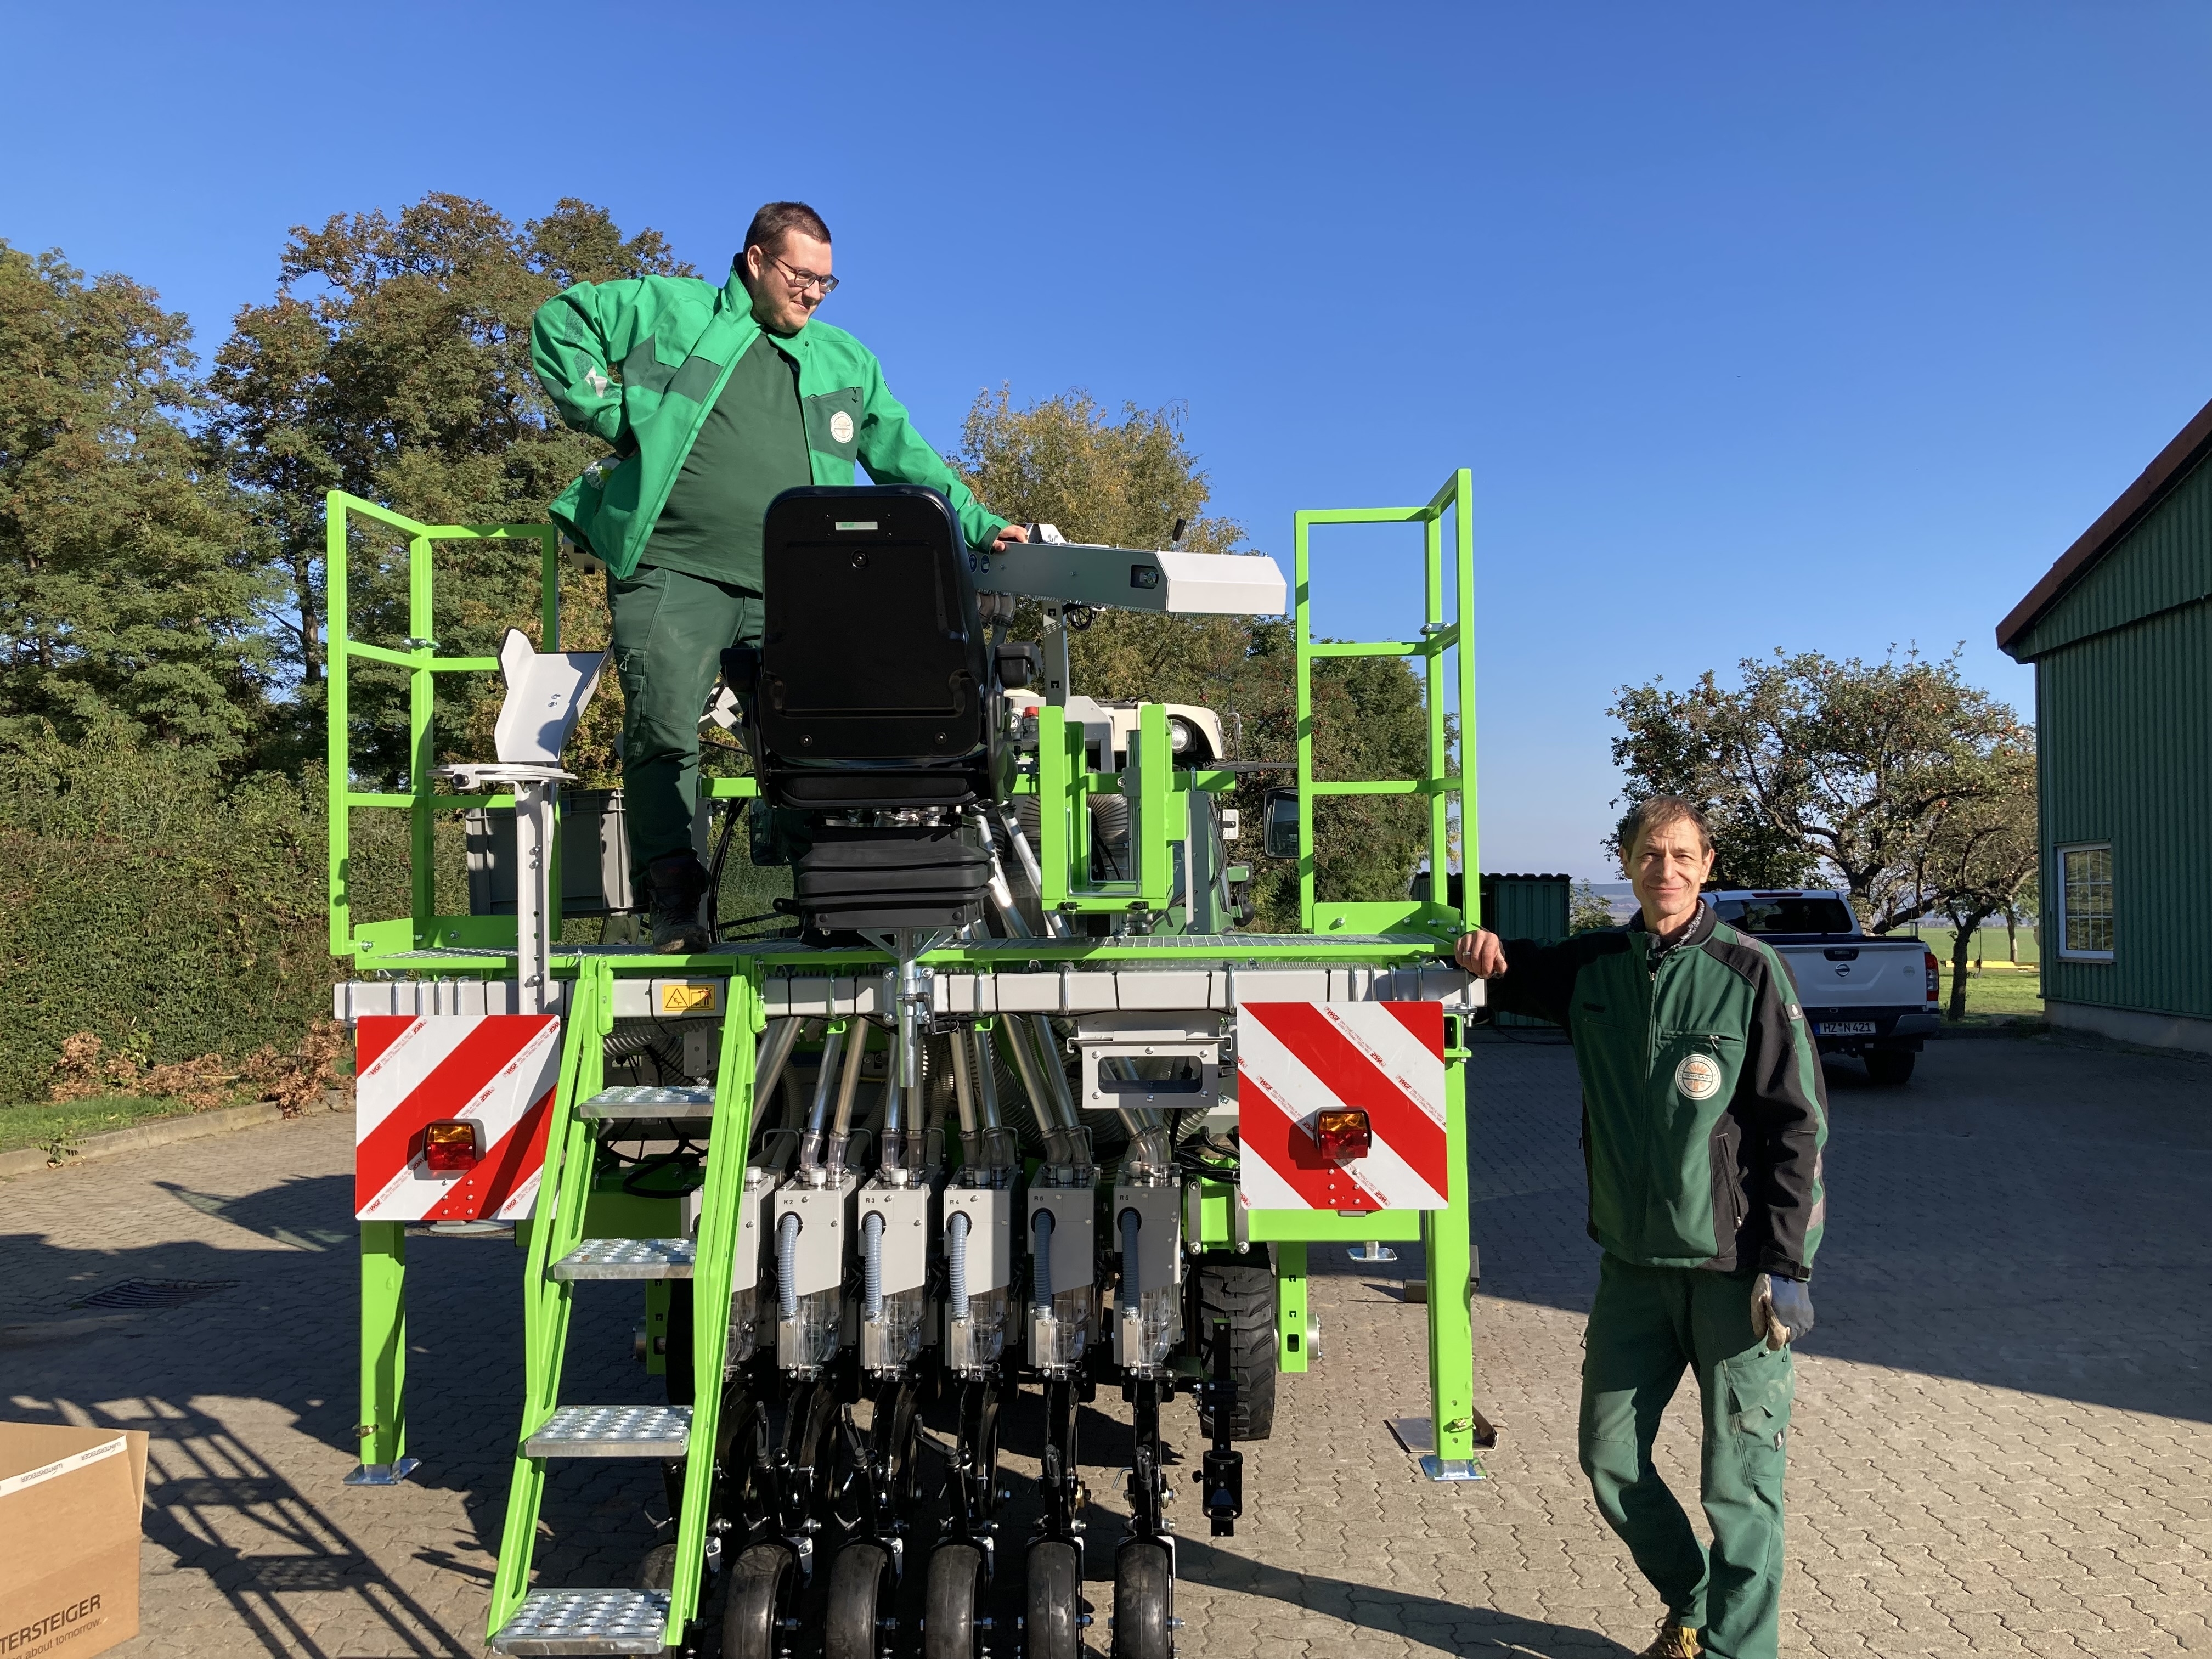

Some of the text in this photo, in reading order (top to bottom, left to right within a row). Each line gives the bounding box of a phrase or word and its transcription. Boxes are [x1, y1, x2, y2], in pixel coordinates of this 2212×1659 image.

[1328, 1010, 1340, 1021] WGF
[413, 1023, 424, 1035] WGF
[1824, 1022, 1872, 1033] HZ N 421
[1370, 1053, 1383, 1064] WGF
[370, 1063, 381, 1074] WGF
[506, 1062, 517, 1074] WGF
[1261, 1079, 1273, 1090] WGF
[1399, 1078, 1412, 1089] WGF
[481, 1089, 492, 1102] WGF
[1374, 1192, 1387, 1203] WGF
[370, 1199, 380, 1211] WGF
[506, 1198, 517, 1210] WGF
[81, 1441, 121, 1460] WINTERSTEIGER
[21, 1463, 63, 1483] WINTERSTEIGER
[25, 1617, 103, 1659] about tomorrow.
